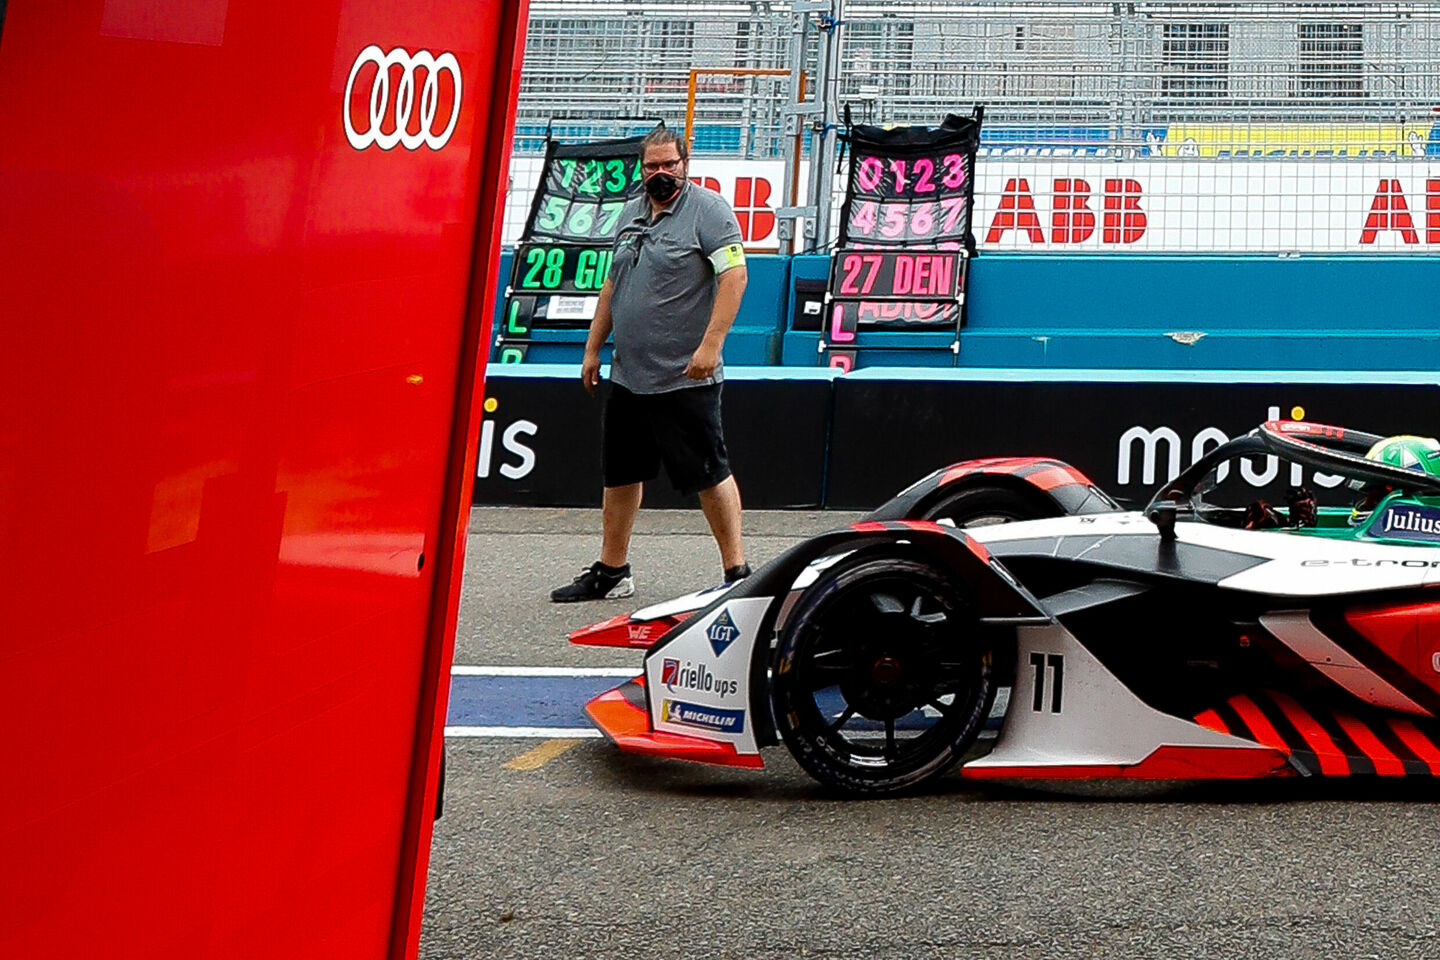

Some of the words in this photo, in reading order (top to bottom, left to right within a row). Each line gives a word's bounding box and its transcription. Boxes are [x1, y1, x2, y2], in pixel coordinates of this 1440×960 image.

[984, 178, 1148, 244] ABB
[522, 248, 565, 289] 28
[840, 254, 883, 295] 27
[892, 254, 953, 296] DEN
[508, 300, 527, 334] L
[831, 304, 855, 342] L
[710, 625, 735, 642] LGT
[679, 661, 714, 691] riello
[714, 679, 738, 698] ups
[1028, 652, 1065, 715] 11
[682, 709, 737, 726] MICHELIN
